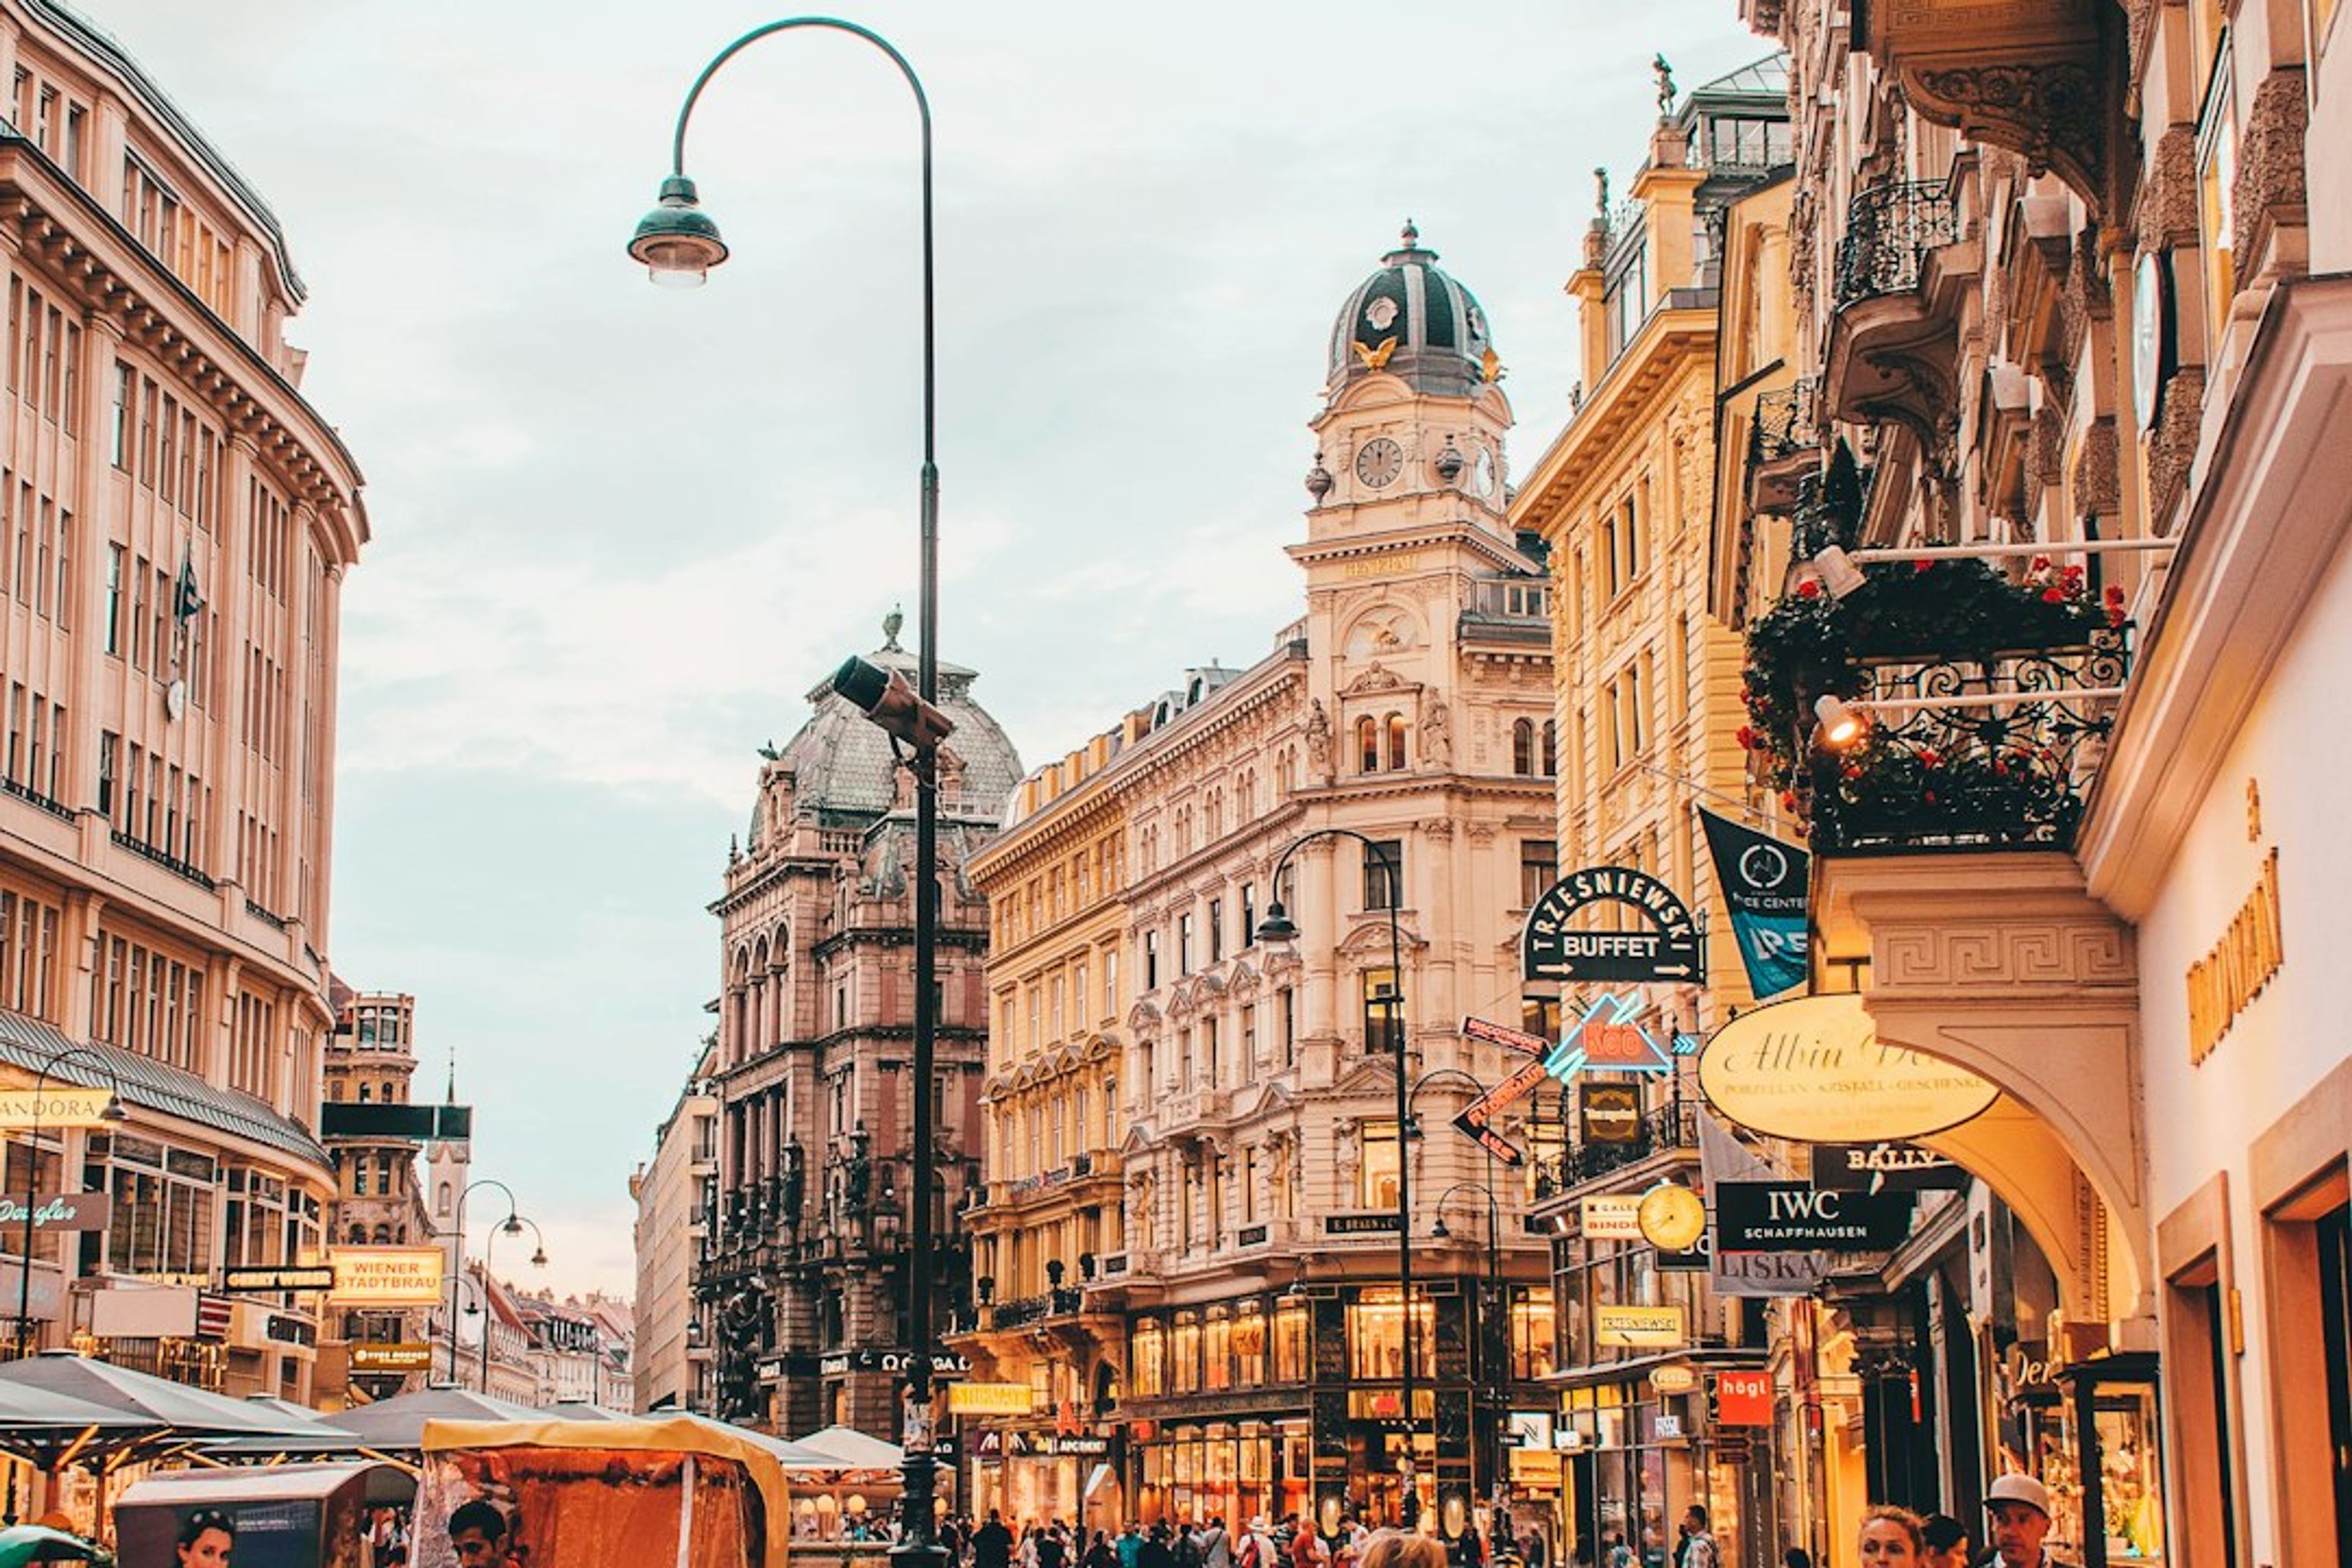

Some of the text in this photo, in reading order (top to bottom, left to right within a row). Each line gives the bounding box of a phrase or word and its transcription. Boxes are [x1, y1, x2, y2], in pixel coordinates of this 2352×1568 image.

[1563, 936, 1660, 957] BUFFET
[1724, 1033, 1849, 1073] Albin
[1847, 1150, 1937, 1171] BALLY
[1768, 1191, 1839, 1221] IWC
[1744, 1226, 1868, 1239] SCHAFFHAUSEN
[353, 1263, 419, 1275] WIENER
[1720, 1253, 1820, 1279] LISKA
[1722, 1380, 1767, 1398] högl
